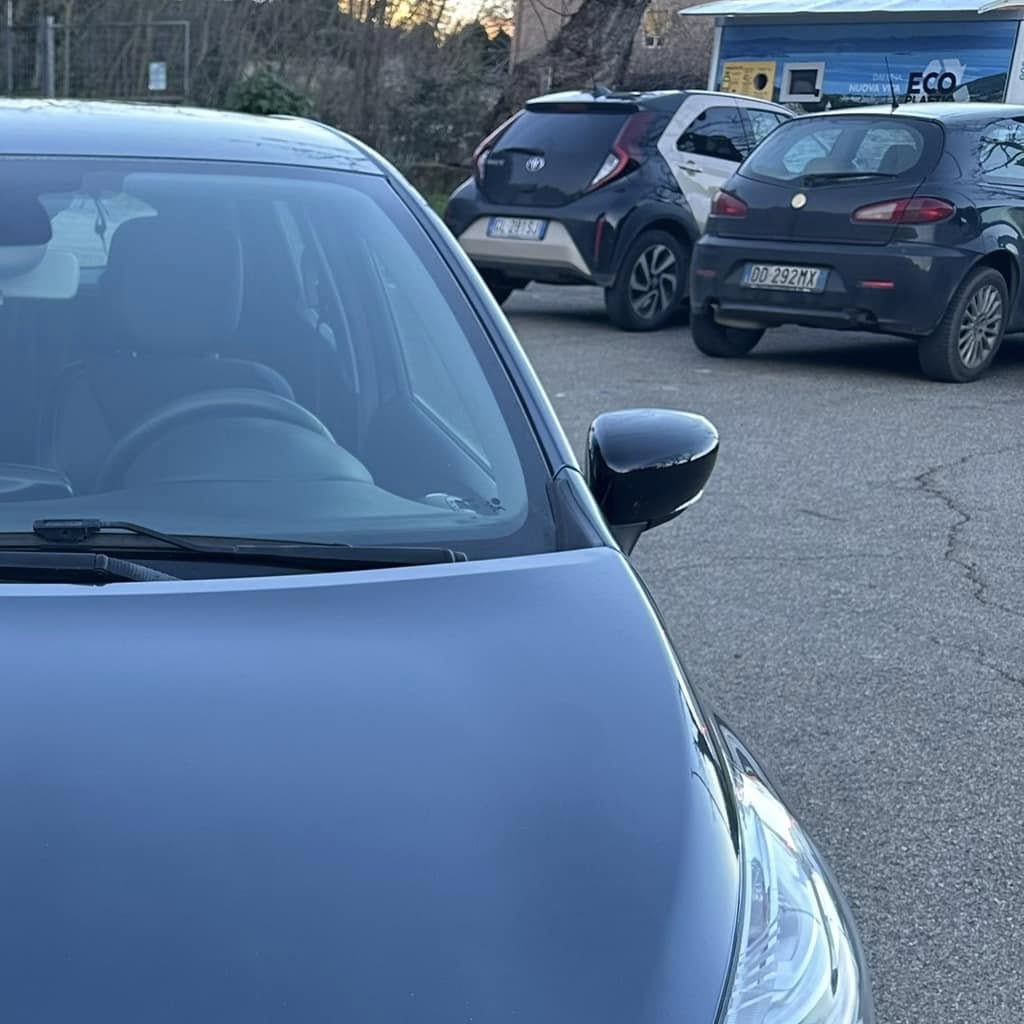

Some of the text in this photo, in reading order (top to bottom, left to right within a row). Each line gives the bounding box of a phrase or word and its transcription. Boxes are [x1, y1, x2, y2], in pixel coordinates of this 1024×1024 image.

[848, 83, 879, 93] NUOVA
[907, 72, 956, 94] ECO
[771, 267, 817, 287] 292MX
